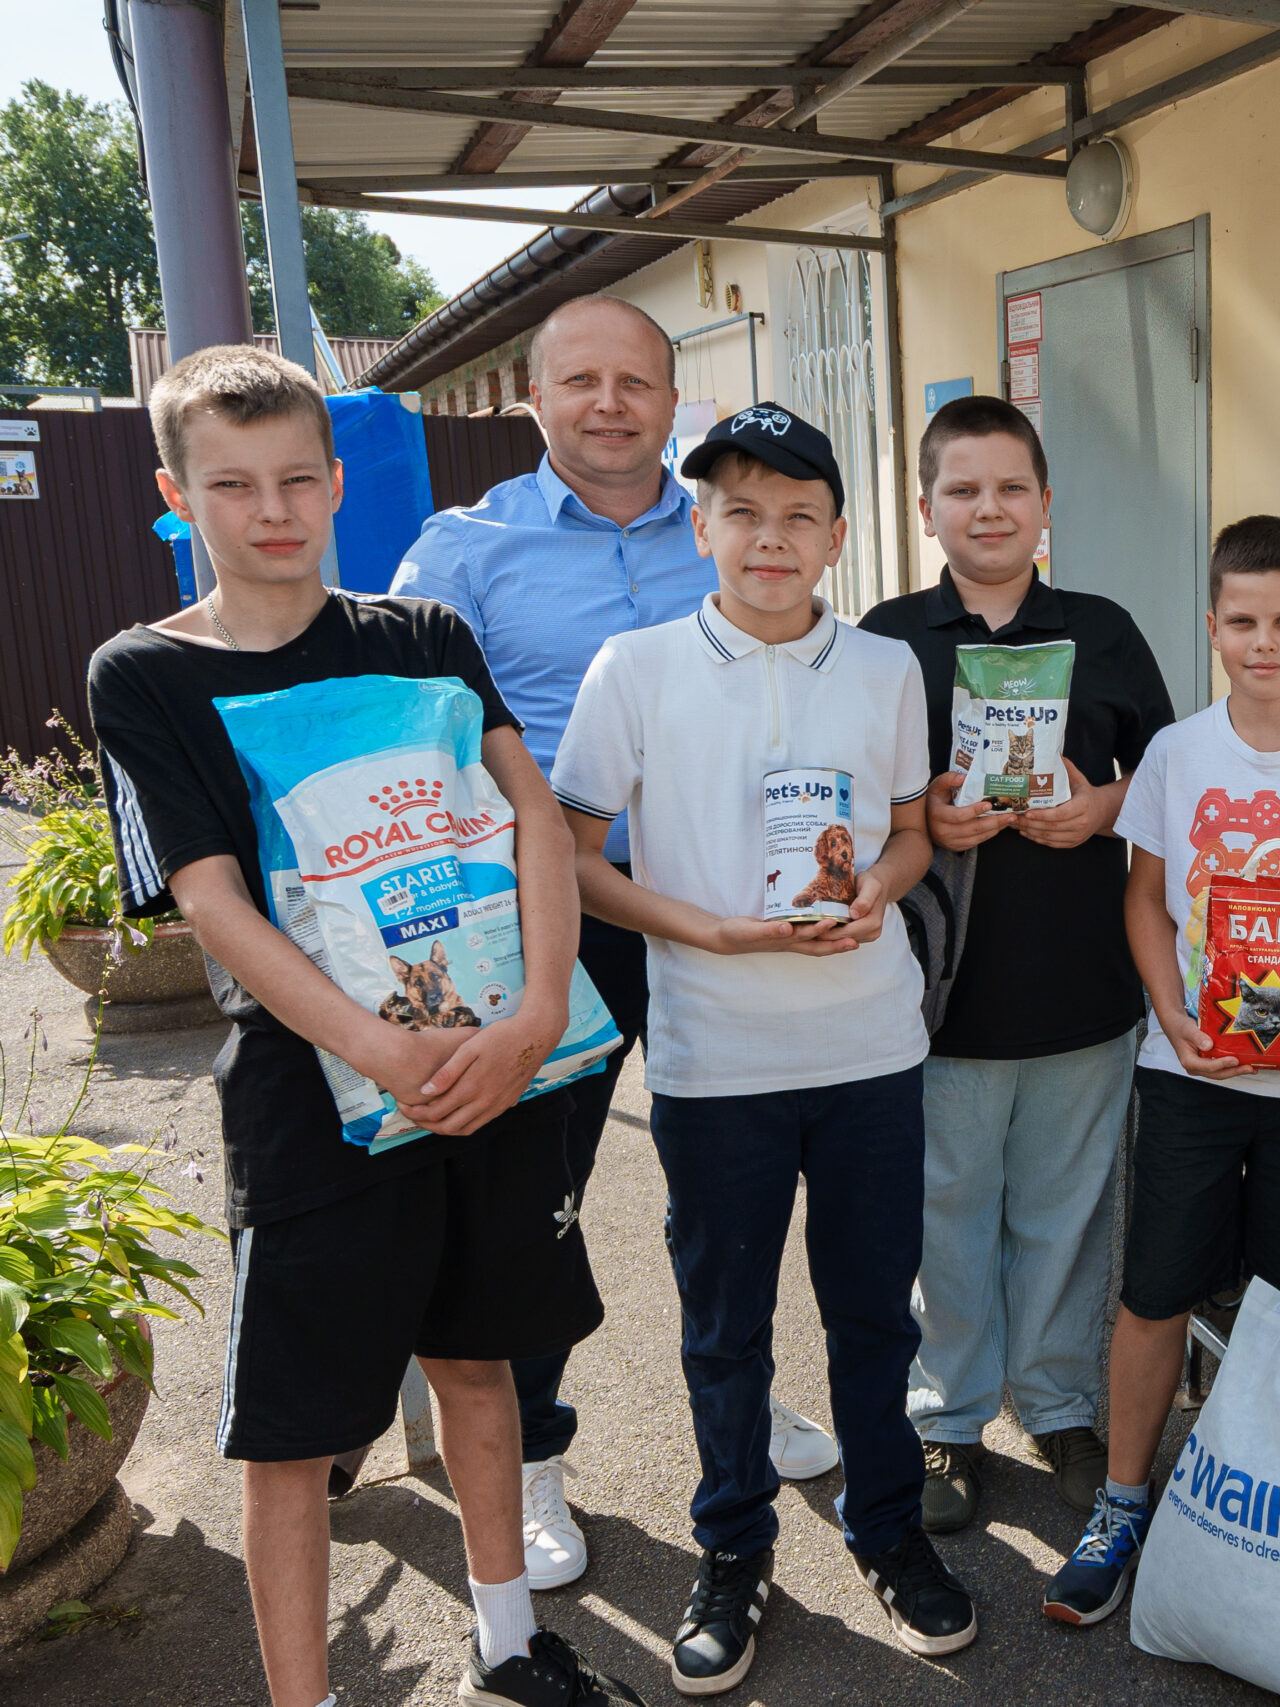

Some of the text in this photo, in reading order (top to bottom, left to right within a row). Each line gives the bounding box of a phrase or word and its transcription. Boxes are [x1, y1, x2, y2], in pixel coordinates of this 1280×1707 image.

[1003, 678, 1028, 690] MEOW
[985, 705, 1058, 725] Pet's Up
[805, 782, 834, 801] Up
[325, 820, 423, 869] ROYAL
[415, 898, 452, 913] months
[1228, 904, 1276, 913] НАПОВНЮВАЧ
[401, 915, 449, 940] MAXI
[1168, 1488, 1197, 1522] everyone
[1197, 1512, 1240, 1548] deserves
[1240, 1535, 1254, 1553] to
